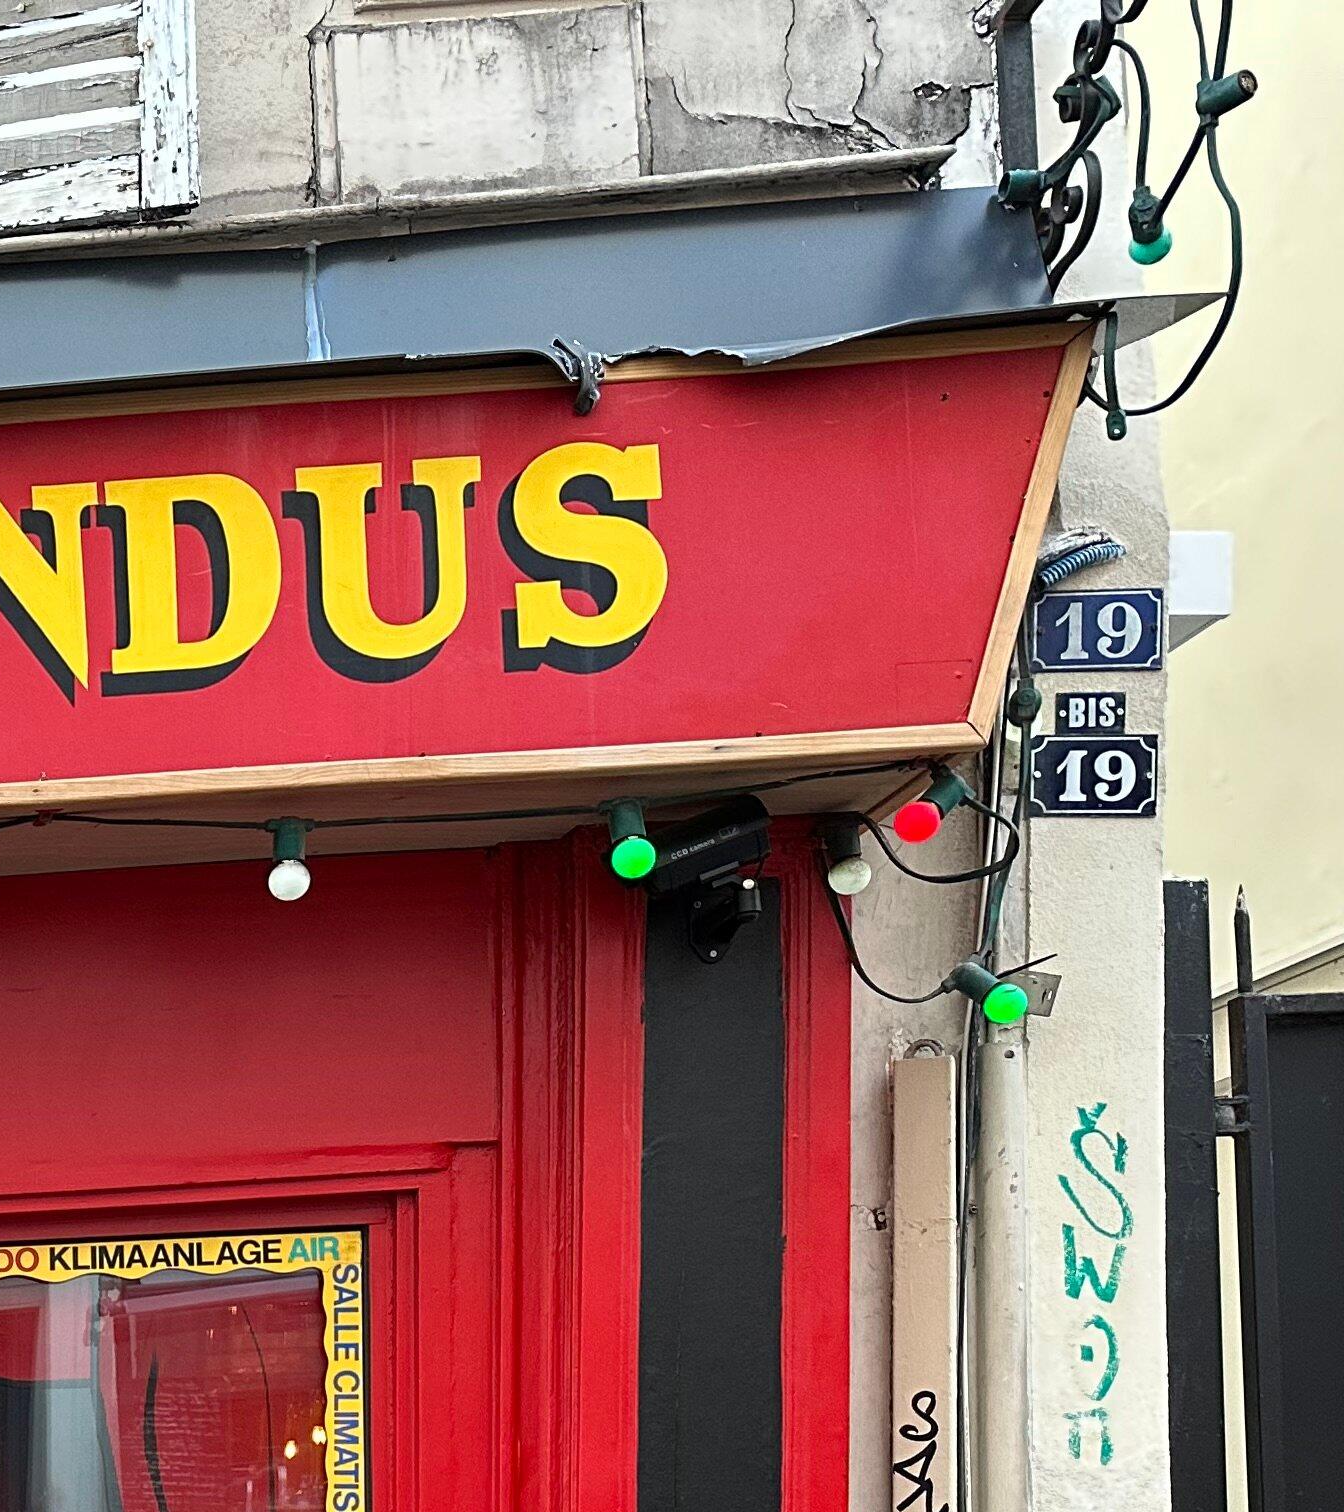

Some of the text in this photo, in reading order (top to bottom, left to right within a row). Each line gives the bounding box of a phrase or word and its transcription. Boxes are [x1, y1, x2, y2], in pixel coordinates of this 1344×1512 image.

[1055, 602, 1142, 659] 19
[1069, 697, 1116, 727] BIS
[1057, 750, 1137, 802] 19
[49, 1239, 283, 1271] KLIMAANLAGE
[287, 1235, 340, 1263] AIR
[332, 1264, 360, 1361] SALLE
